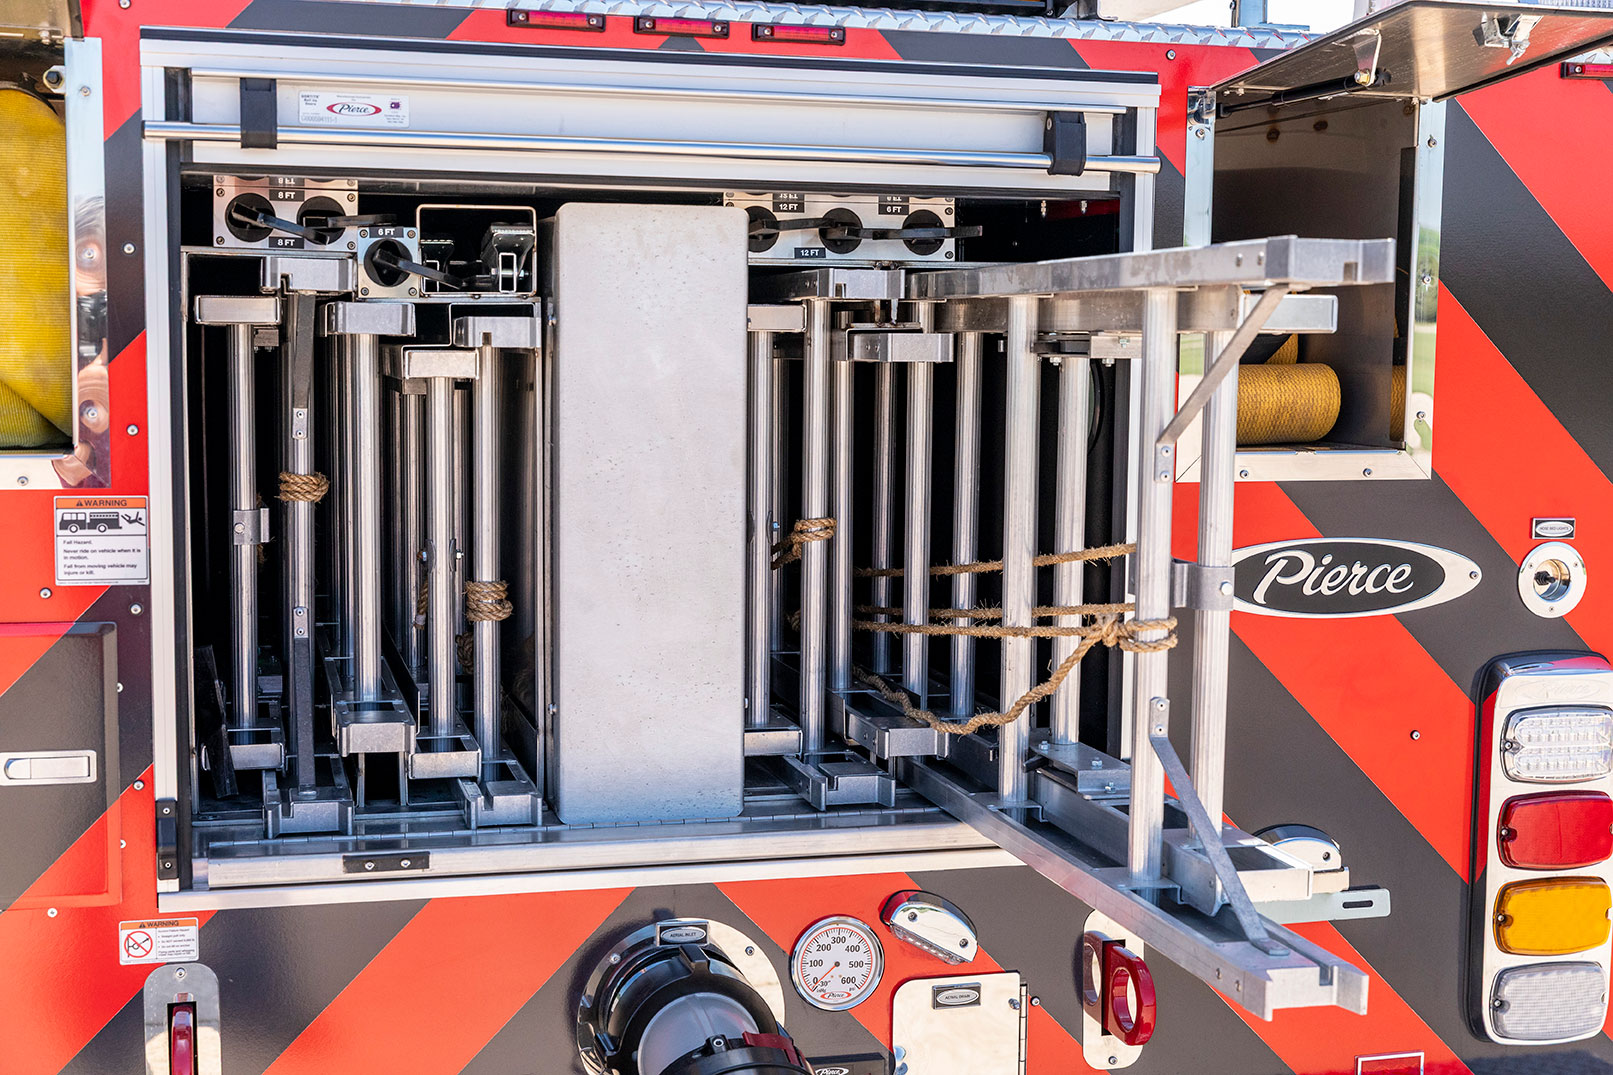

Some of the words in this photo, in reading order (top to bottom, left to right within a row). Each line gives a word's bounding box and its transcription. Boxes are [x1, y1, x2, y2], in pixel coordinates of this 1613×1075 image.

[339, 103, 369, 113] Pierce
[1252, 550, 1414, 604] Pierce
[831, 936, 846, 944] 300
[841, 976, 856, 984] 600
